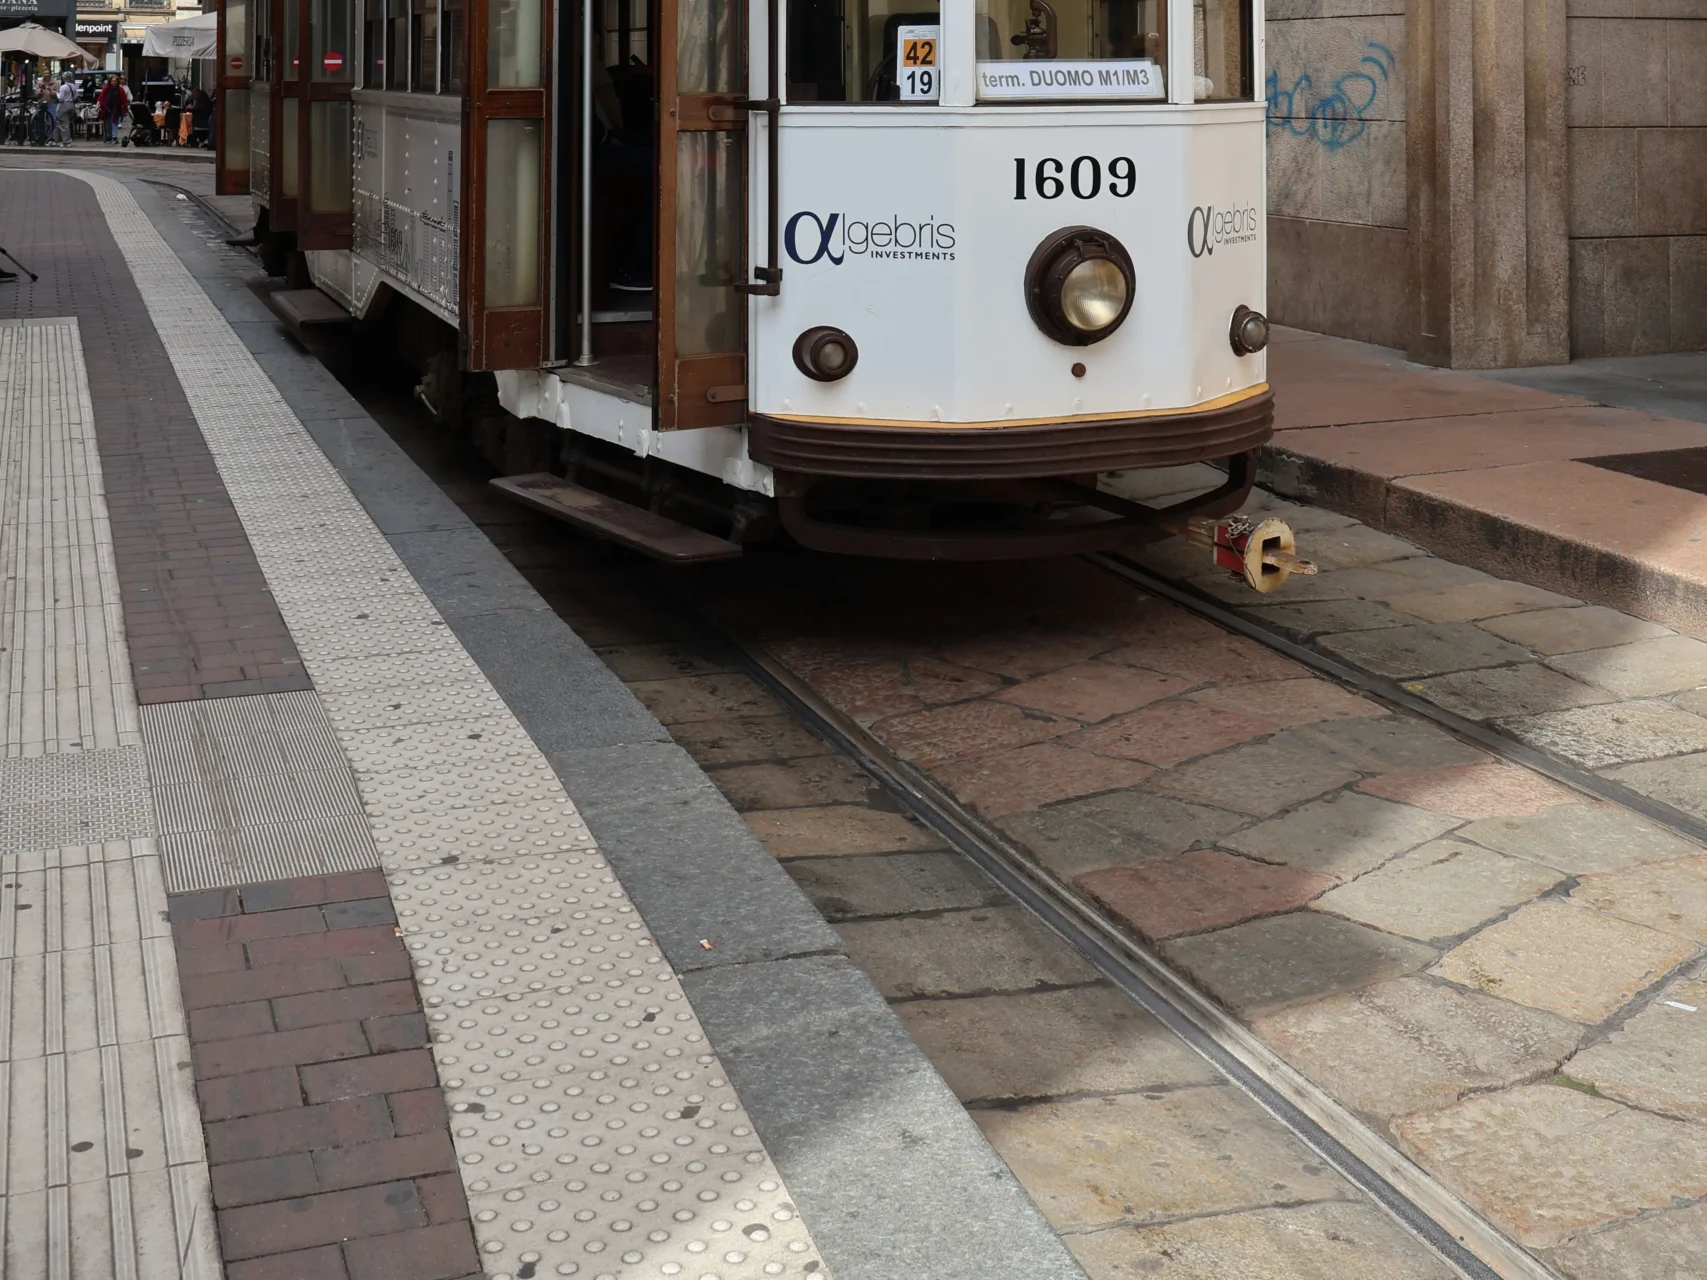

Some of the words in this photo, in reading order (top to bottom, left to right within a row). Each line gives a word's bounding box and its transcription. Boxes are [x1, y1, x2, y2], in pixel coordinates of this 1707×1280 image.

[173, 36, 194, 46] PIZZERIA
[906, 41, 933, 65] 42
[907, 70, 932, 94] 19
[982, 72, 1025, 88] term.
[1029, 69, 1094, 87] DUOMO
[1098, 69, 1149, 86] M1/M3
[1013, 155, 1137, 200] 1609
[1223, 234, 1257, 245] INVESTMENTS
[871, 250, 956, 261] INVESTMENTS
